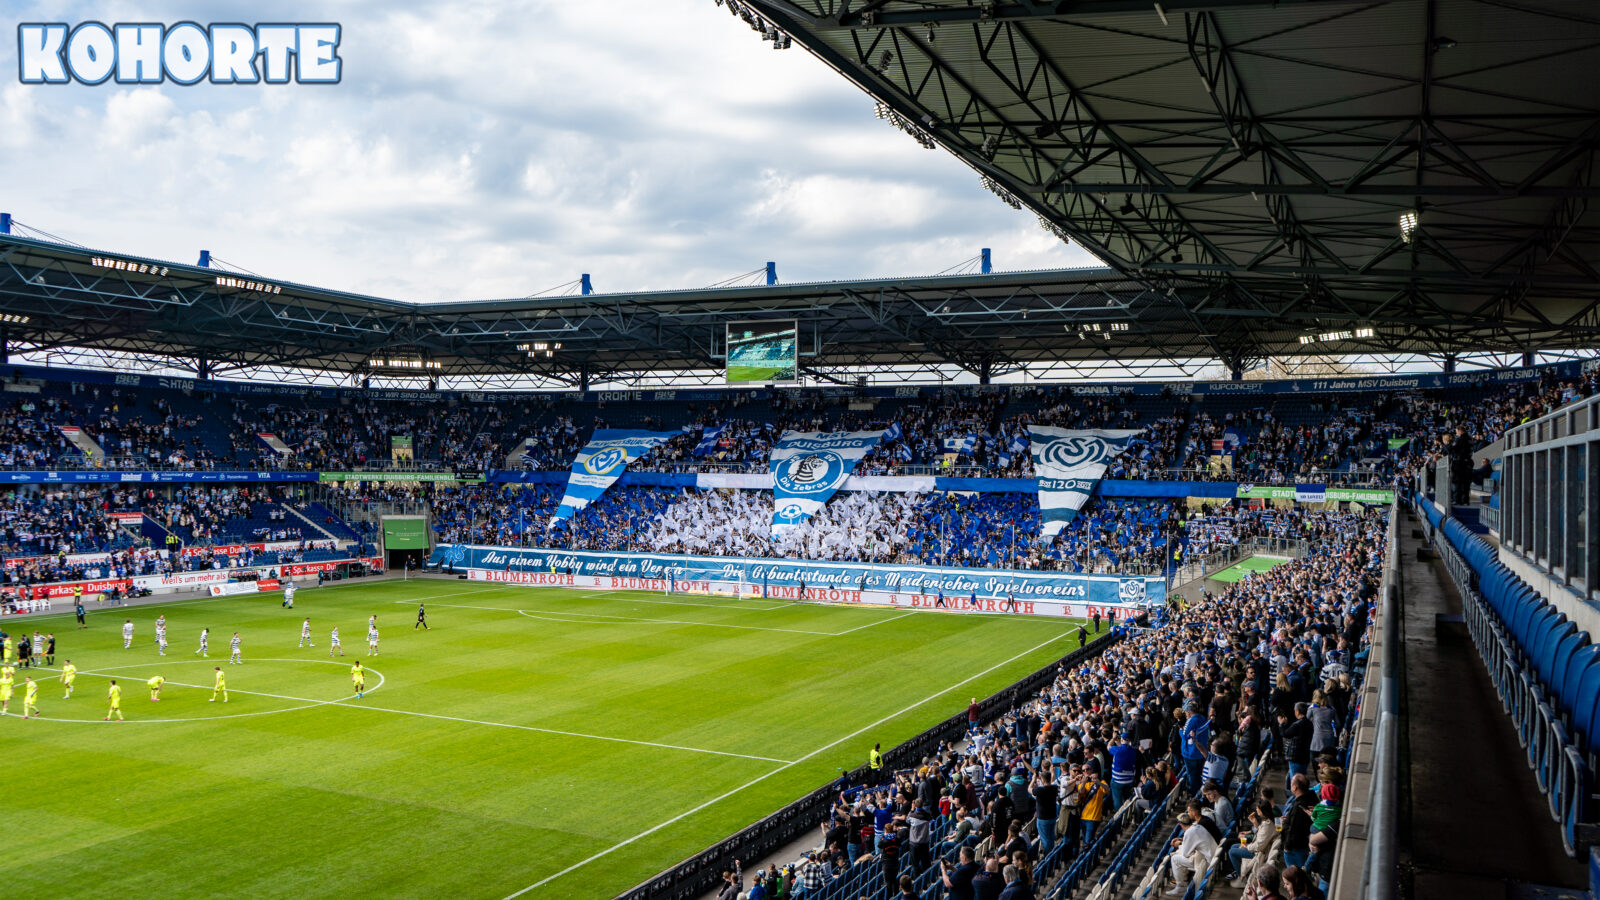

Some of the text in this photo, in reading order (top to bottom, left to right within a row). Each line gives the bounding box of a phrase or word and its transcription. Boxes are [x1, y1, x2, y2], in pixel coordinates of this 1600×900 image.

[1497, 371, 1514, 381] WIR
[1515, 369, 1534, 379] SIND
[1313, 378, 1419, 389] 111 Jahre MSV Duisburg
[786, 439, 864, 450] DUISBURG
[780, 476, 828, 491] Die Zebras
[1052, 480, 1076, 489] 120
[161, 575, 183, 585] Weil's
[184, 576, 197, 584] um
[197, 573, 215, 584] mehr
[216, 571, 227, 582] als
[481, 550, 505, 566] Aus
[509, 553, 542, 567] einem
[546, 553, 584, 574] Hobby
[586, 558, 617, 573] wird
[619, 560, 637, 573] ein
[723, 563, 745, 578] Die
[854, 572, 882, 586] des
[885, 572, 980, 592] Meidericher
[984, 576, 1086, 598] Spielvereins
[486, 571, 575, 586] BLUMENROTH
